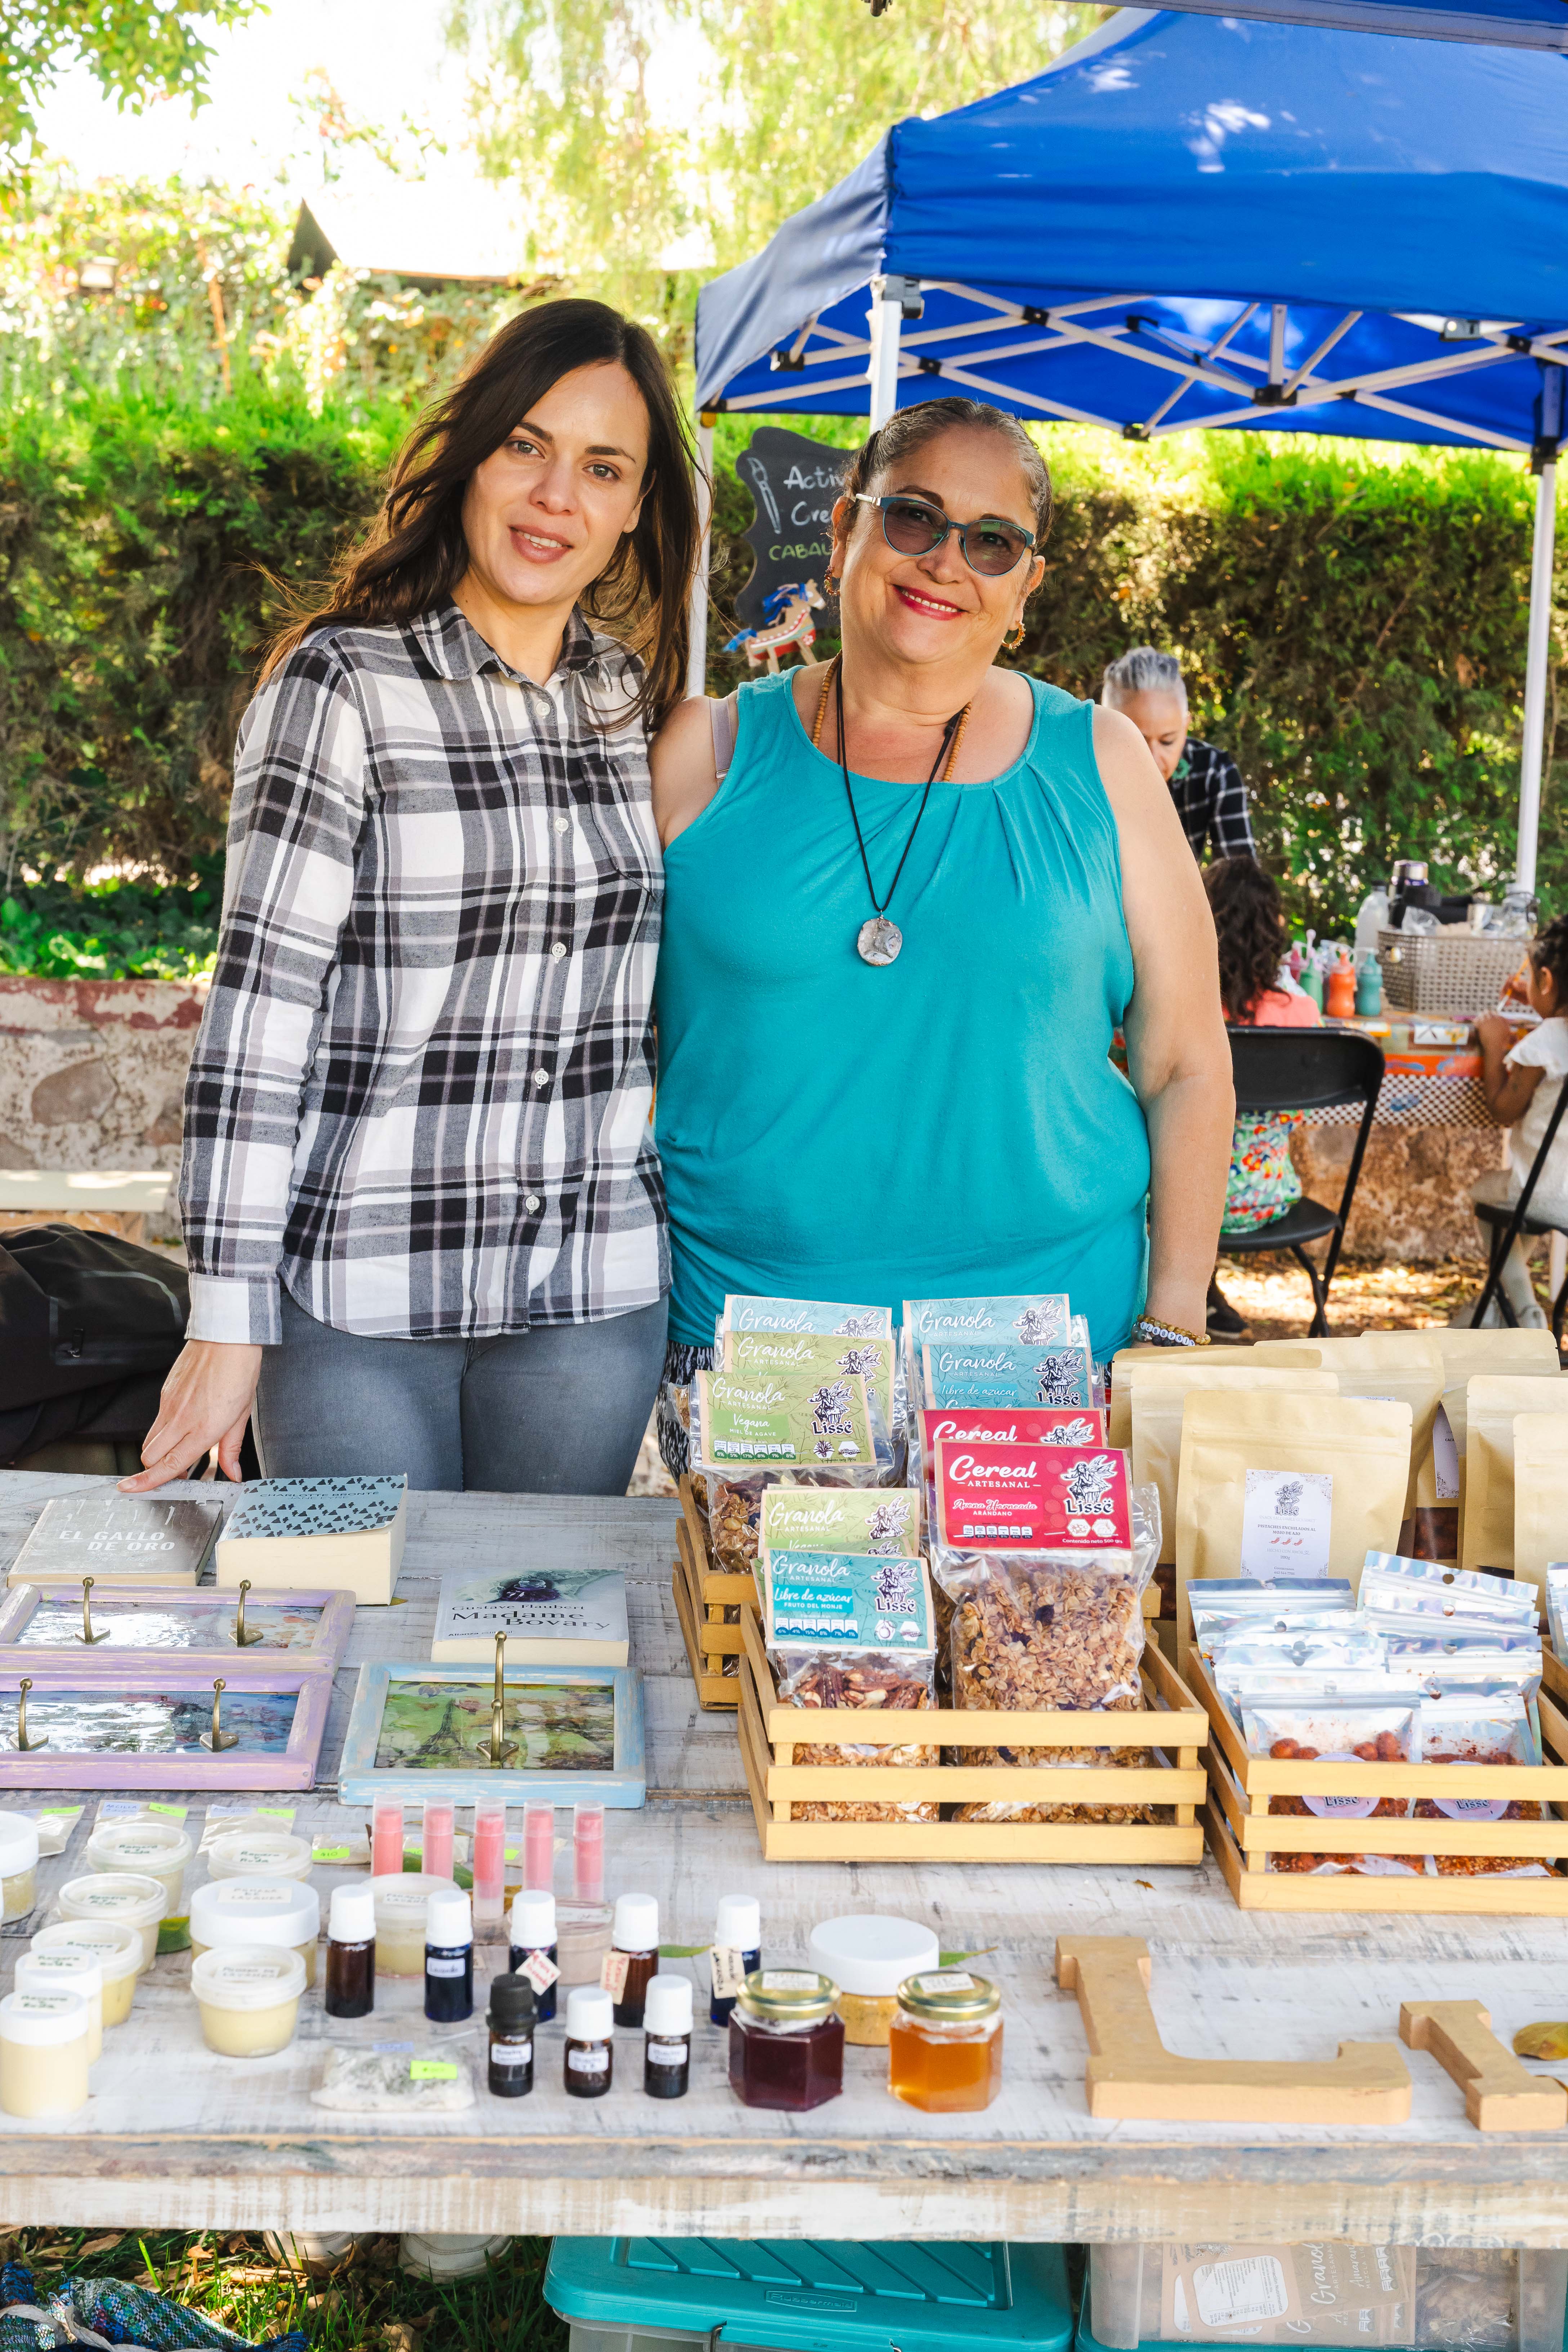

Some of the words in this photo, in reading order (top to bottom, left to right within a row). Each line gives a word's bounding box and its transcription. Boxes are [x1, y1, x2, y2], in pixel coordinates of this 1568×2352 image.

[739, 1308, 816, 1332] Granola
[919, 1307, 995, 1333] Granola
[738, 1337, 814, 1359] Granola
[939, 1352, 1016, 1372] Granola
[712, 1378, 785, 1403] Granola
[966, 1383, 980, 1395] de
[982, 1386, 1017, 1397] azúcar
[727, 1401, 771, 1410] ARTESANAL
[1037, 1392, 1080, 1405] Lissë
[733, 1414, 770, 1433] Vegana
[813, 1421, 853, 1435] Lissë
[933, 1421, 1018, 1441] Cereal
[949, 1456, 1037, 1481] Cereal
[952, 1499, 985, 1510] Avena
[986, 1499, 1037, 1510] Horneada
[1066, 1499, 1113, 1514] Lissë
[1276, 1506, 1298, 1515] Lissë
[769, 1499, 845, 1527] Granola
[59, 1530, 84, 1539] EL
[94, 1532, 165, 1540] GALLO
[87, 1542, 118, 1551] DE
[127, 1542, 175, 1550] ORO
[772, 1555, 850, 1577] Granola
[774, 1588, 799, 1602] Libre
[801, 1589, 814, 1601] de
[816, 1591, 853, 1604] azúcar
[876, 1598, 916, 1612] Lissë
[453, 1611, 584, 1620] Madame
[505, 1619, 610, 1630] Bovary
[1055, 1935, 1412, 2125] L
[1362, 2261, 1371, 2289] MEZCLA
[1270, 2258, 1278, 2284] Información
[1275, 2285, 1283, 2312] Nutrimental
[771, 2293, 853, 2308] Rubbermaid
